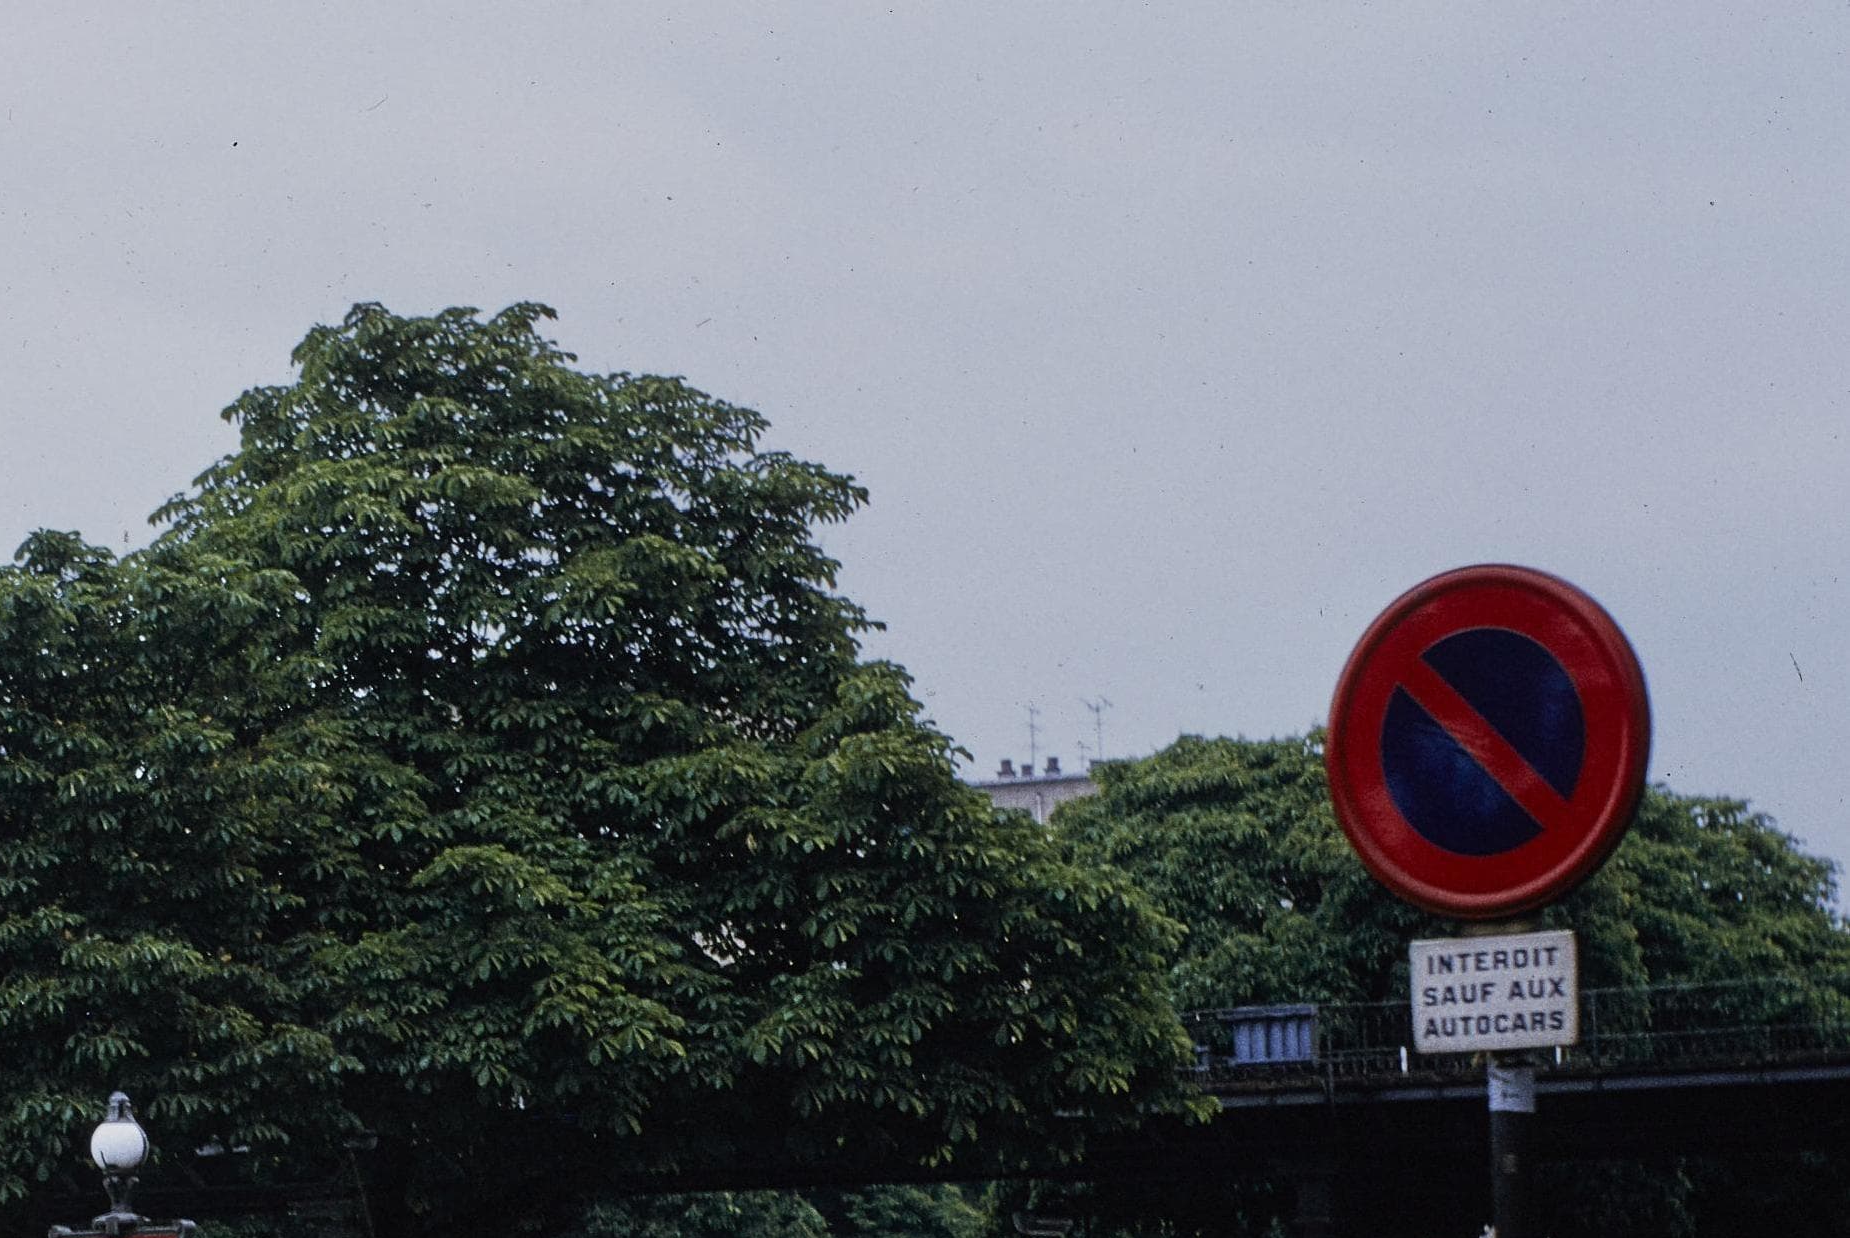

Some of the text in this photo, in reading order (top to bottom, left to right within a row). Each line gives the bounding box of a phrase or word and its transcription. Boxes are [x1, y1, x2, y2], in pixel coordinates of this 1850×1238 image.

[1427, 947, 1557, 976] INTERDIT
[1423, 977, 1565, 1007] SAUF AUX
[1424, 1010, 1564, 1039] AUTOCARS
